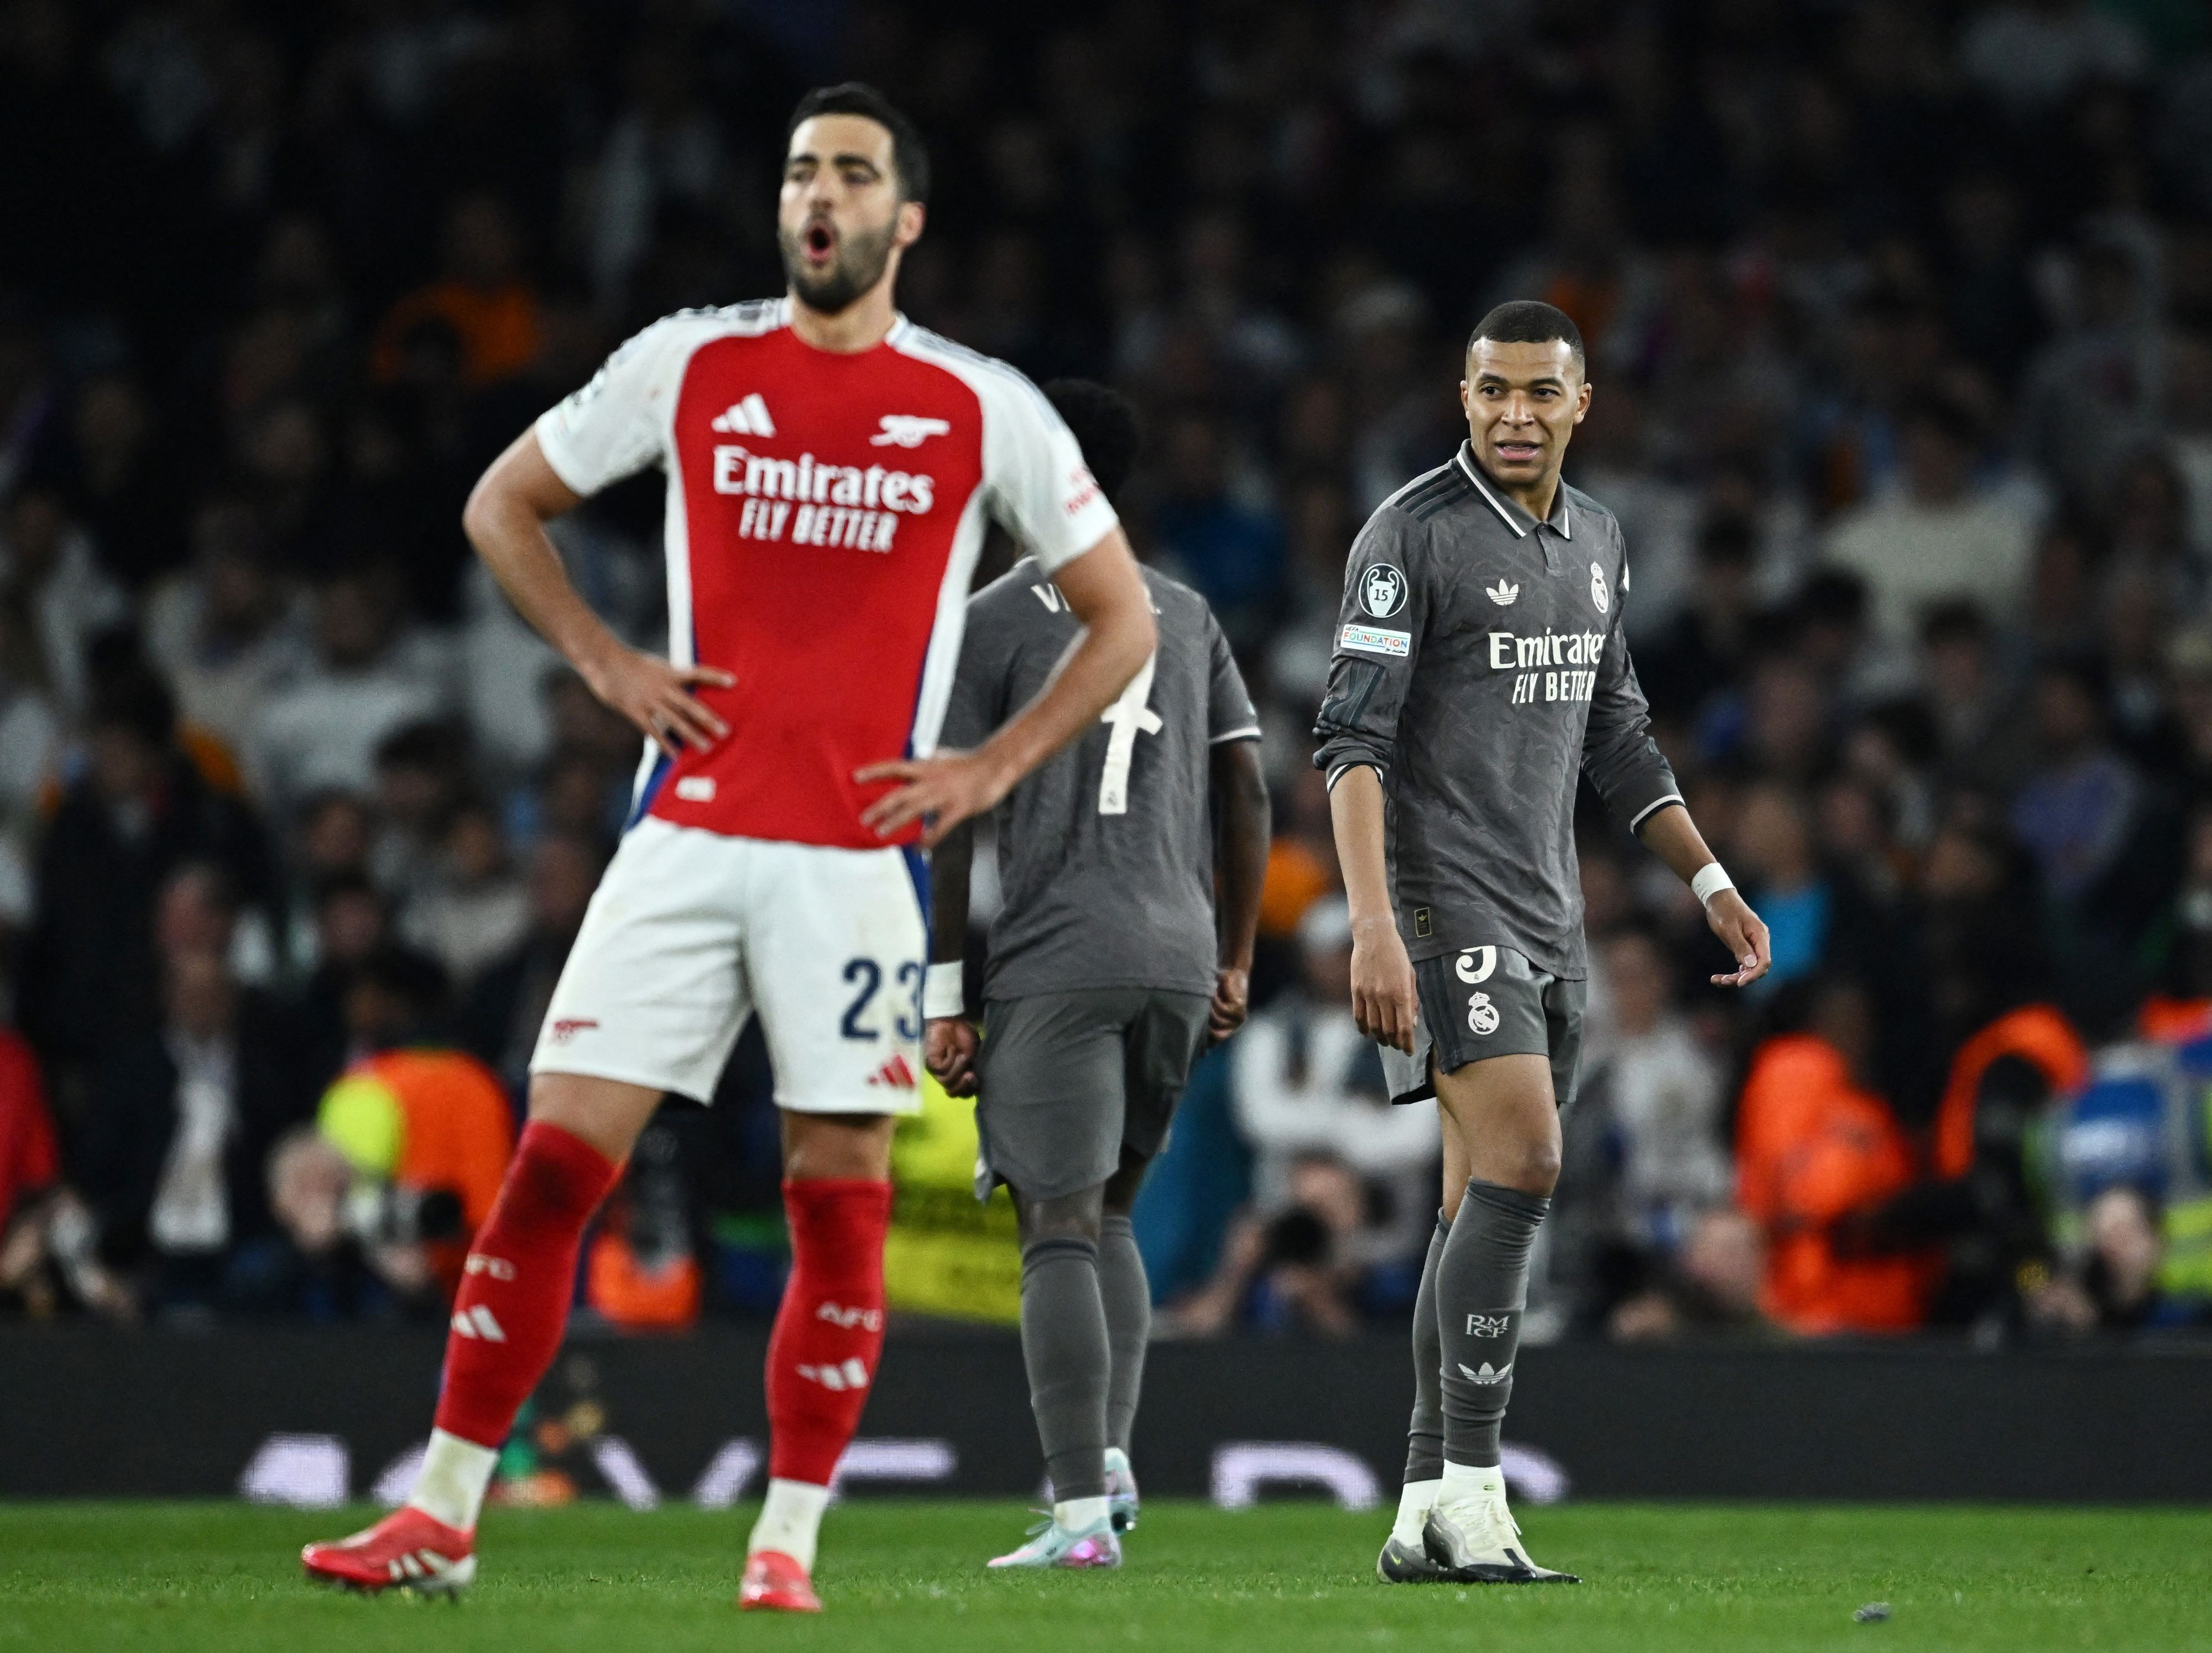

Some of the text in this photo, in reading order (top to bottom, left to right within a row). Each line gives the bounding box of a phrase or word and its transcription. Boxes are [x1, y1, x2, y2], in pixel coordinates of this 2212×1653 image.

[713, 444, 935, 515] Emirates
[738, 496, 899, 553] FLY BETTER
[1374, 589, 1389, 601] 15
[1512, 670, 1596, 704] FLY BETTER
[843, 959, 925, 1040] 23
